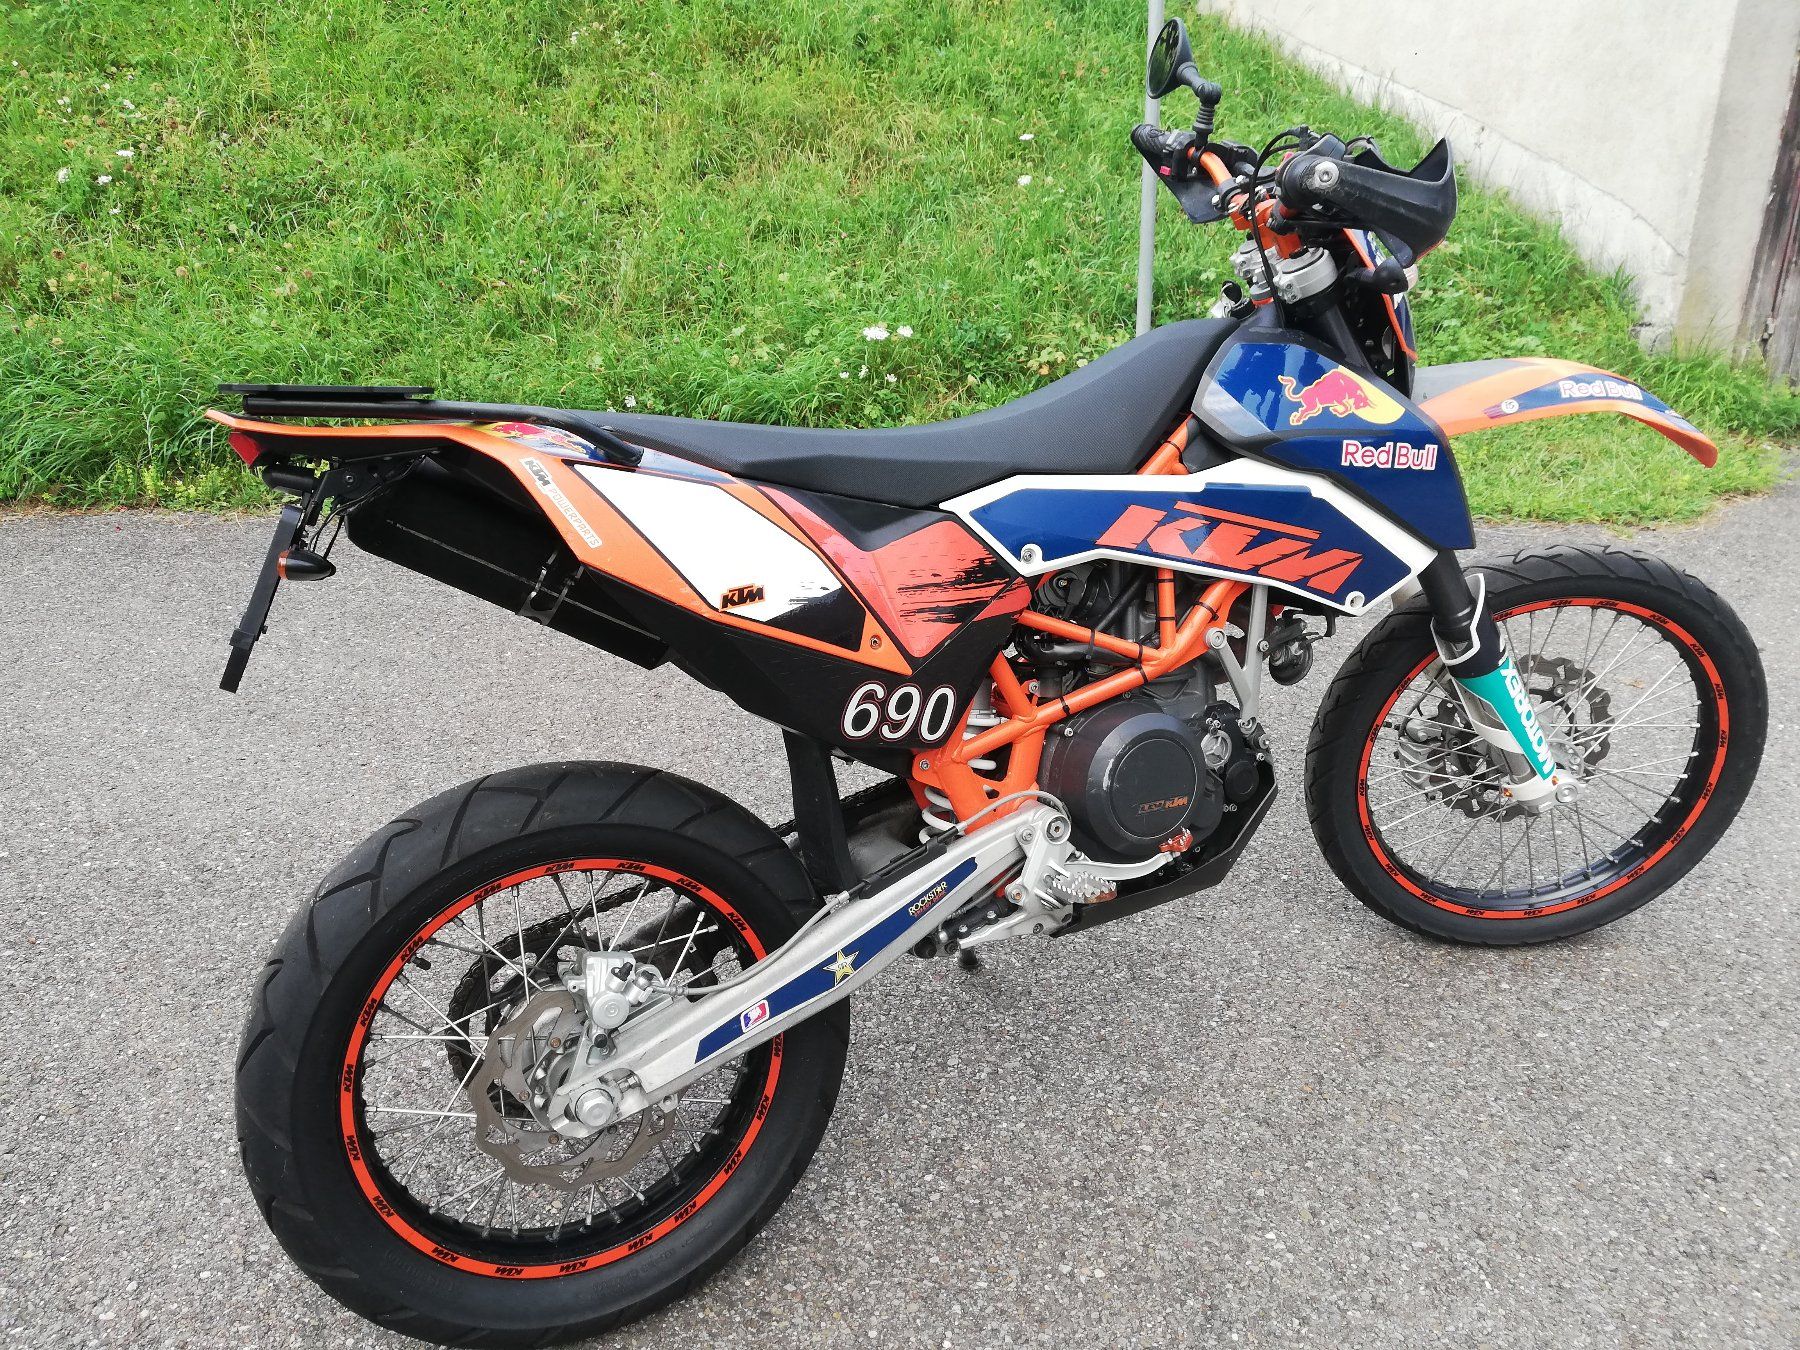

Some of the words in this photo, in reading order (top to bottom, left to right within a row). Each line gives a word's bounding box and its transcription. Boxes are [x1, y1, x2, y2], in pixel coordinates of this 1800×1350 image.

[1560, 380, 1603, 399] Red
[1604, 381, 1642, 400] Bull
[1342, 440, 1393, 468] Red
[1394, 442, 1438, 470] Bull
[524, 459, 552, 487] KTM
[550, 487, 600, 547] POWERPARTS
[1095, 500, 1363, 594] KTM
[719, 583, 765, 611] KTM
[840, 681, 956, 743] 690
[545, 862, 576, 873] KTM
[616, 862, 646, 872] KTM
[474, 884, 501, 901] KTM
[675, 878, 702, 892] KTM
[726, 912, 748, 932] KTM
[400, 936, 423, 961] KTM
[360, 998, 377, 1027] KTM
[344, 1064, 354, 1093] KTM
[756, 1094, 770, 1122] KTM
[346, 1134, 360, 1161] KTM
[723, 1149, 742, 1175] KTM
[370, 1195, 395, 1218] KTM
[674, 1200, 697, 1223] KTM
[627, 1232, 653, 1251] KTM
[430, 1246, 459, 1263] KTM
[494, 1266, 525, 1276] KTM
[559, 1260, 588, 1273] KTM
